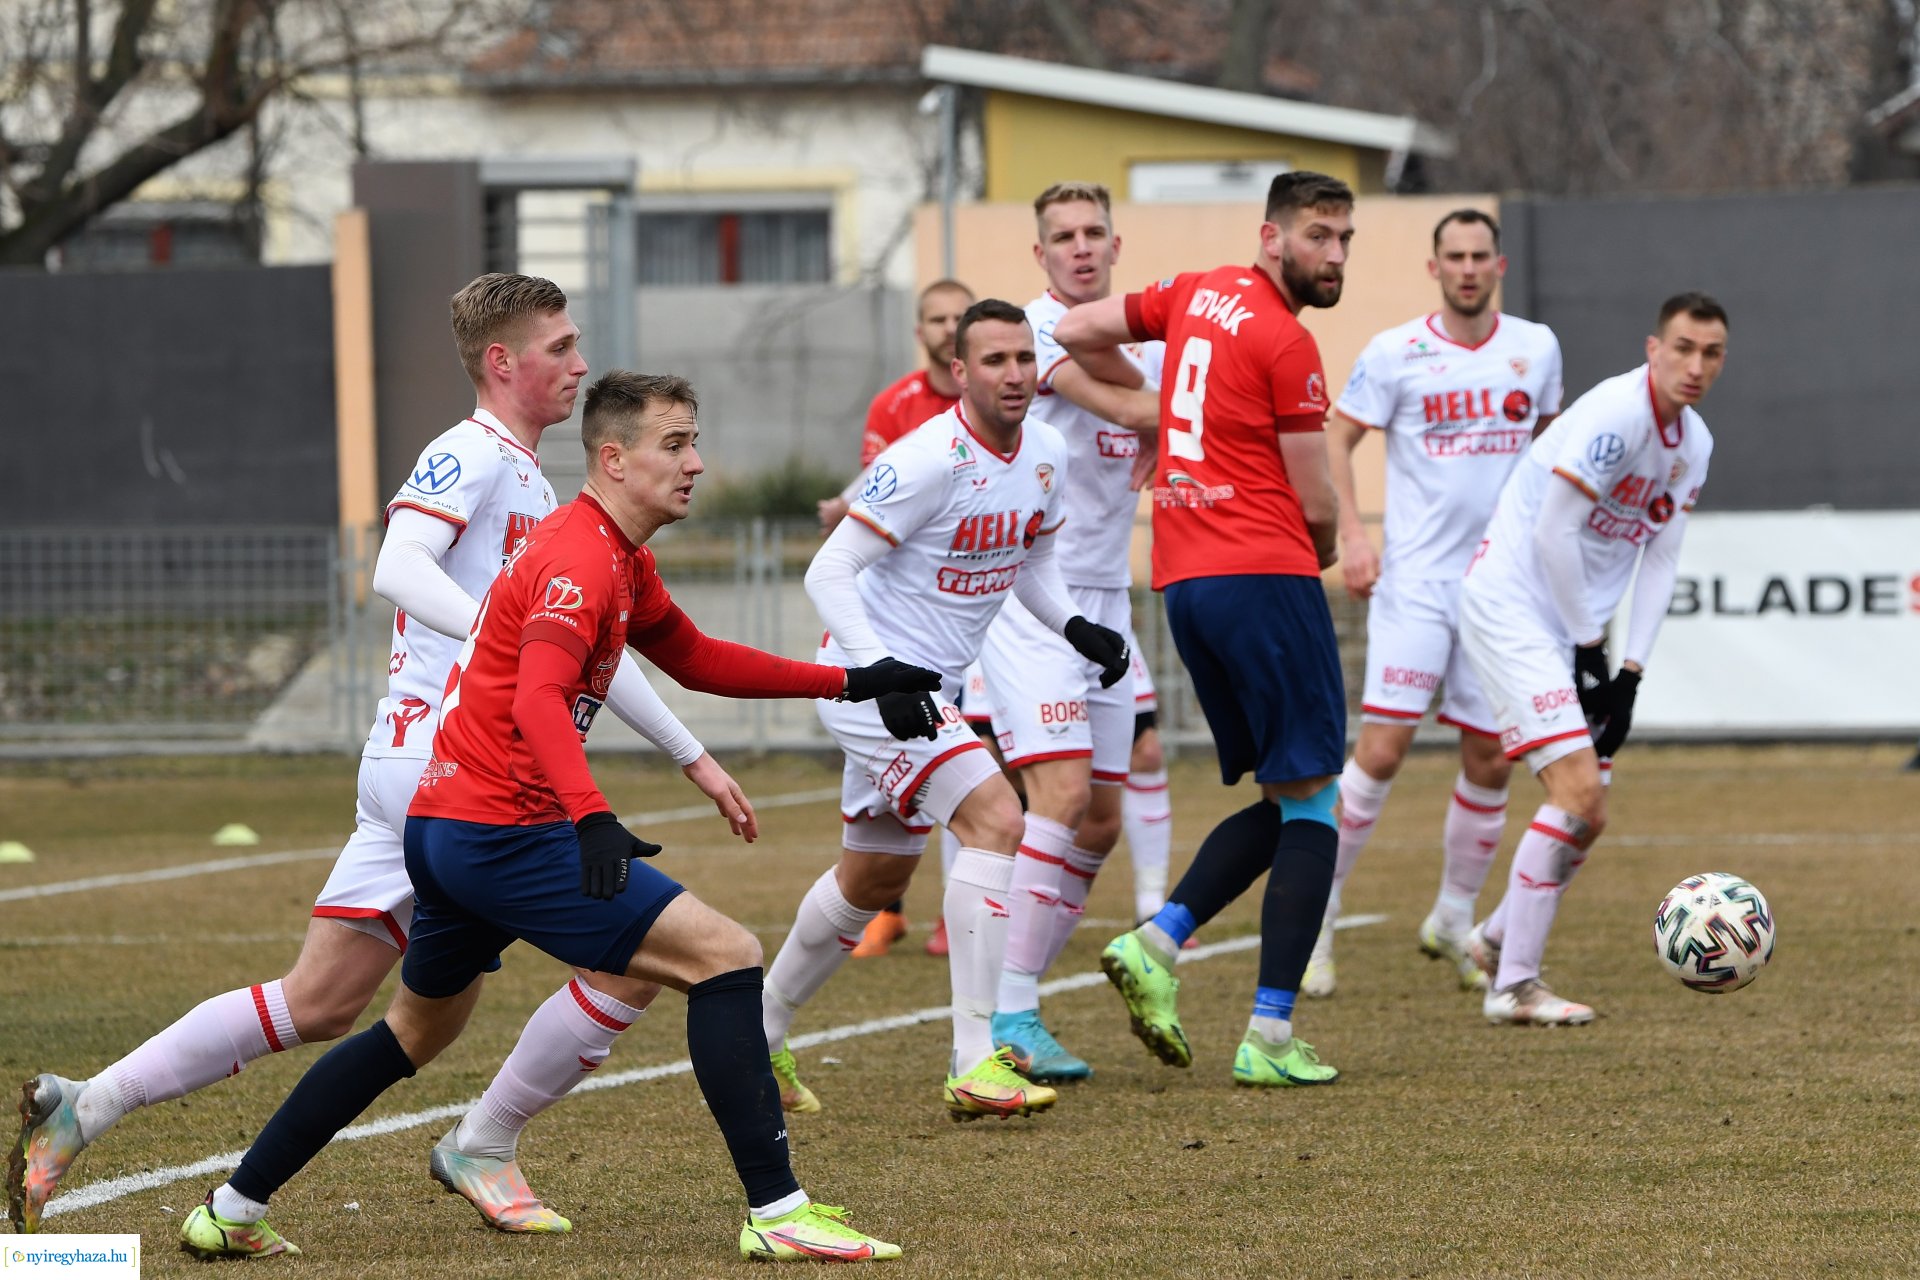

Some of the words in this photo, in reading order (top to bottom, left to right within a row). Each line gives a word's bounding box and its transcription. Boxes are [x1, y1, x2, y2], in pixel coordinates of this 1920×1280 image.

[1167, 335, 1213, 463] 9
[1423, 387, 1497, 424] HELL
[951, 509, 1020, 553] HELL
[1667, 576, 1920, 616] BLADE
